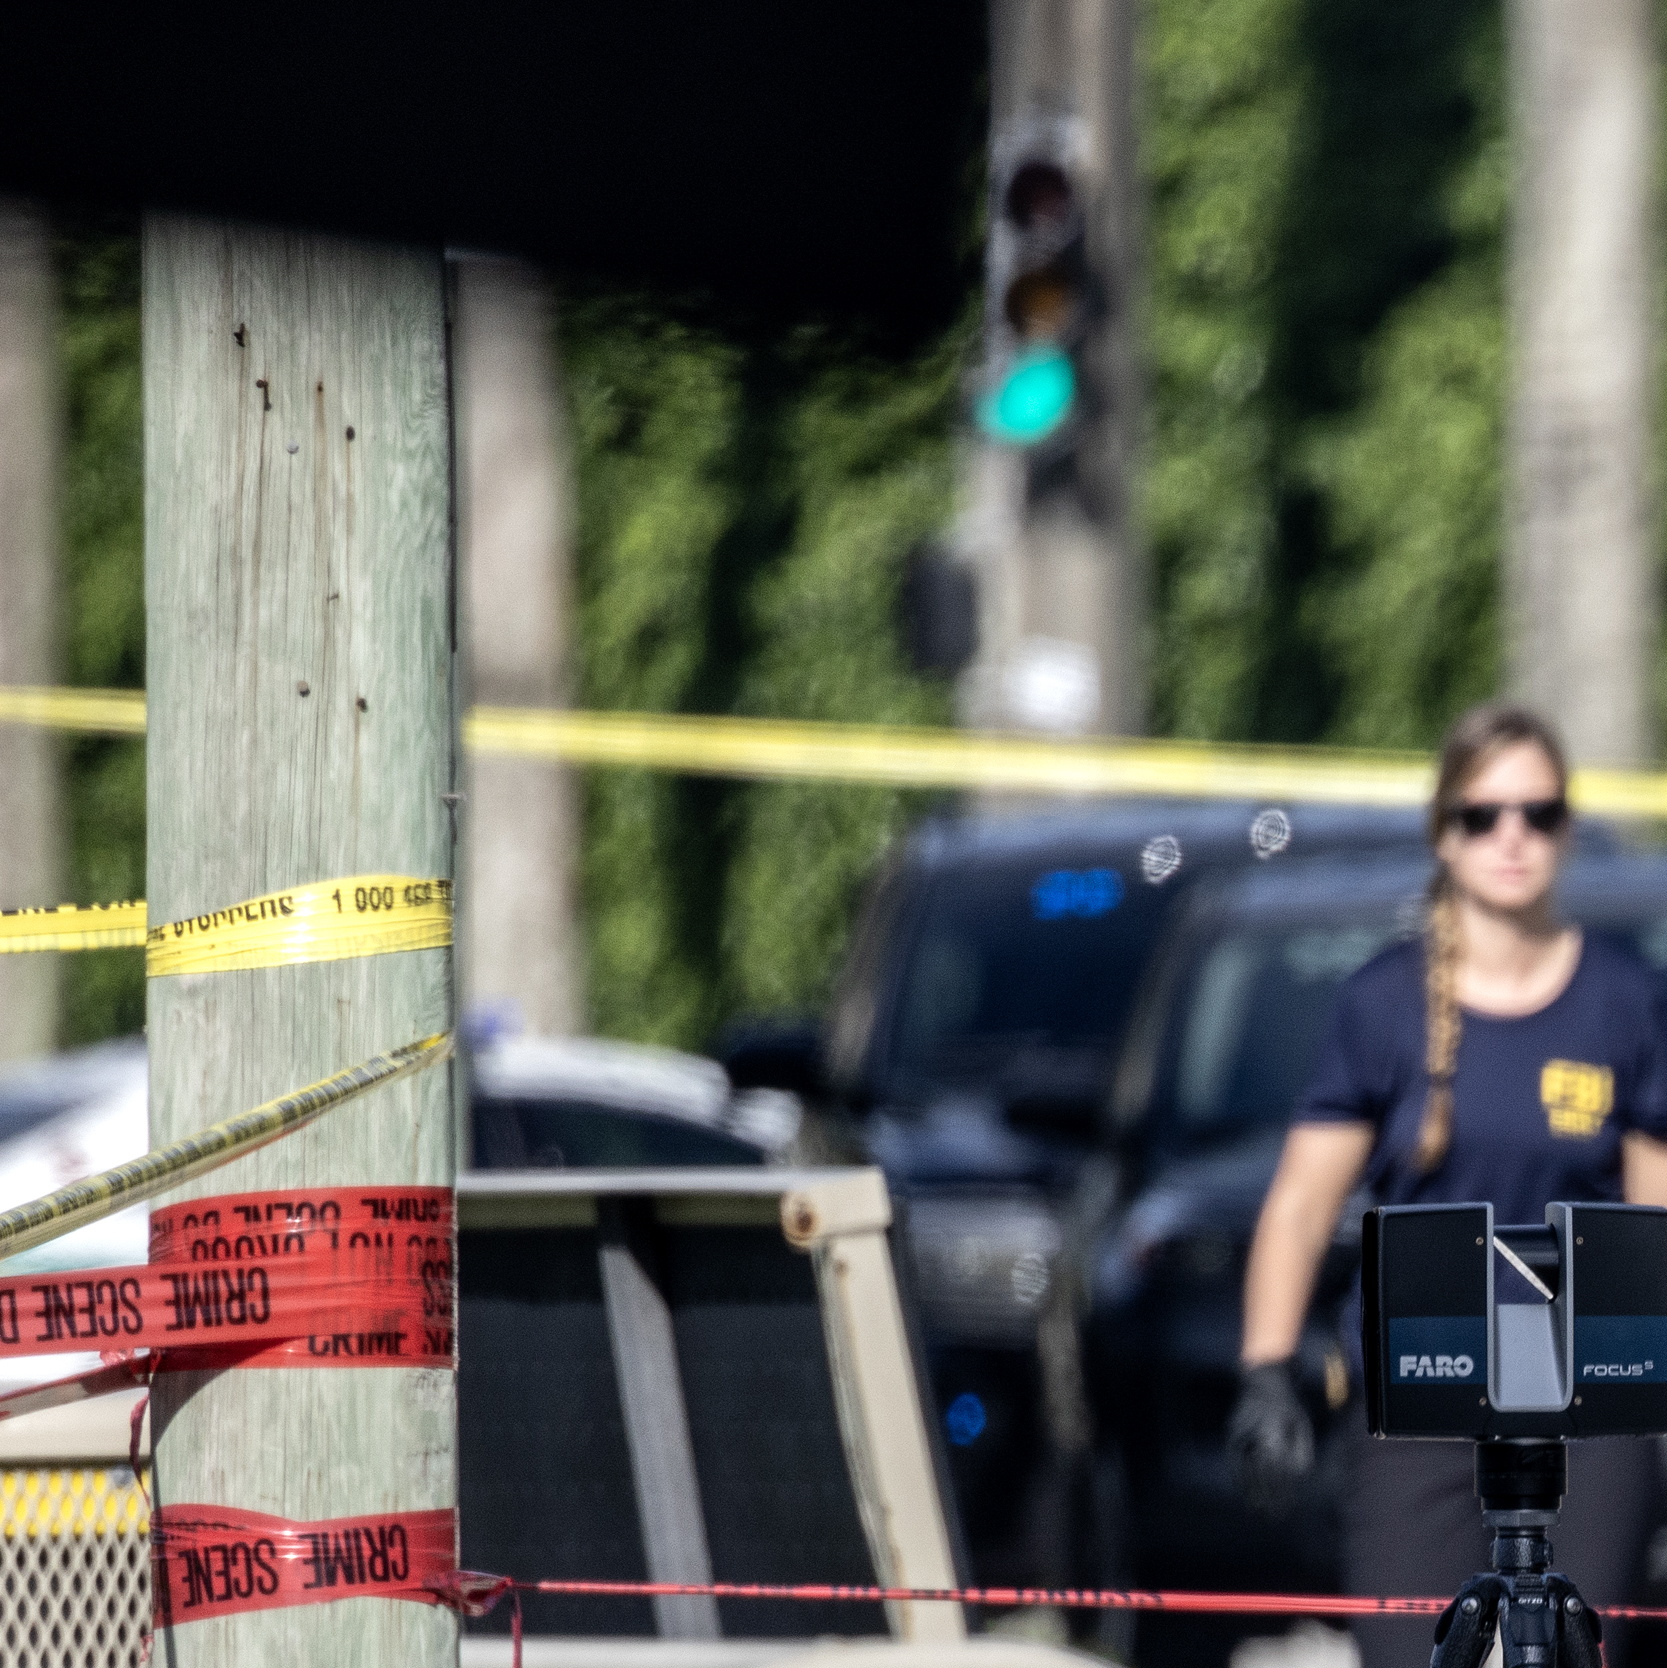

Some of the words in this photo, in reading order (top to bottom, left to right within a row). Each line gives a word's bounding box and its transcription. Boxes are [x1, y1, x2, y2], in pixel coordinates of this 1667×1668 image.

[32, 1277, 144, 1342] SCENE
[160, 1266, 271, 1332] CRIME
[1399, 1354, 1474, 1378] FARO
[177, 1538, 279, 1608] SCENE
[299, 1524, 409, 1590] CRIME
